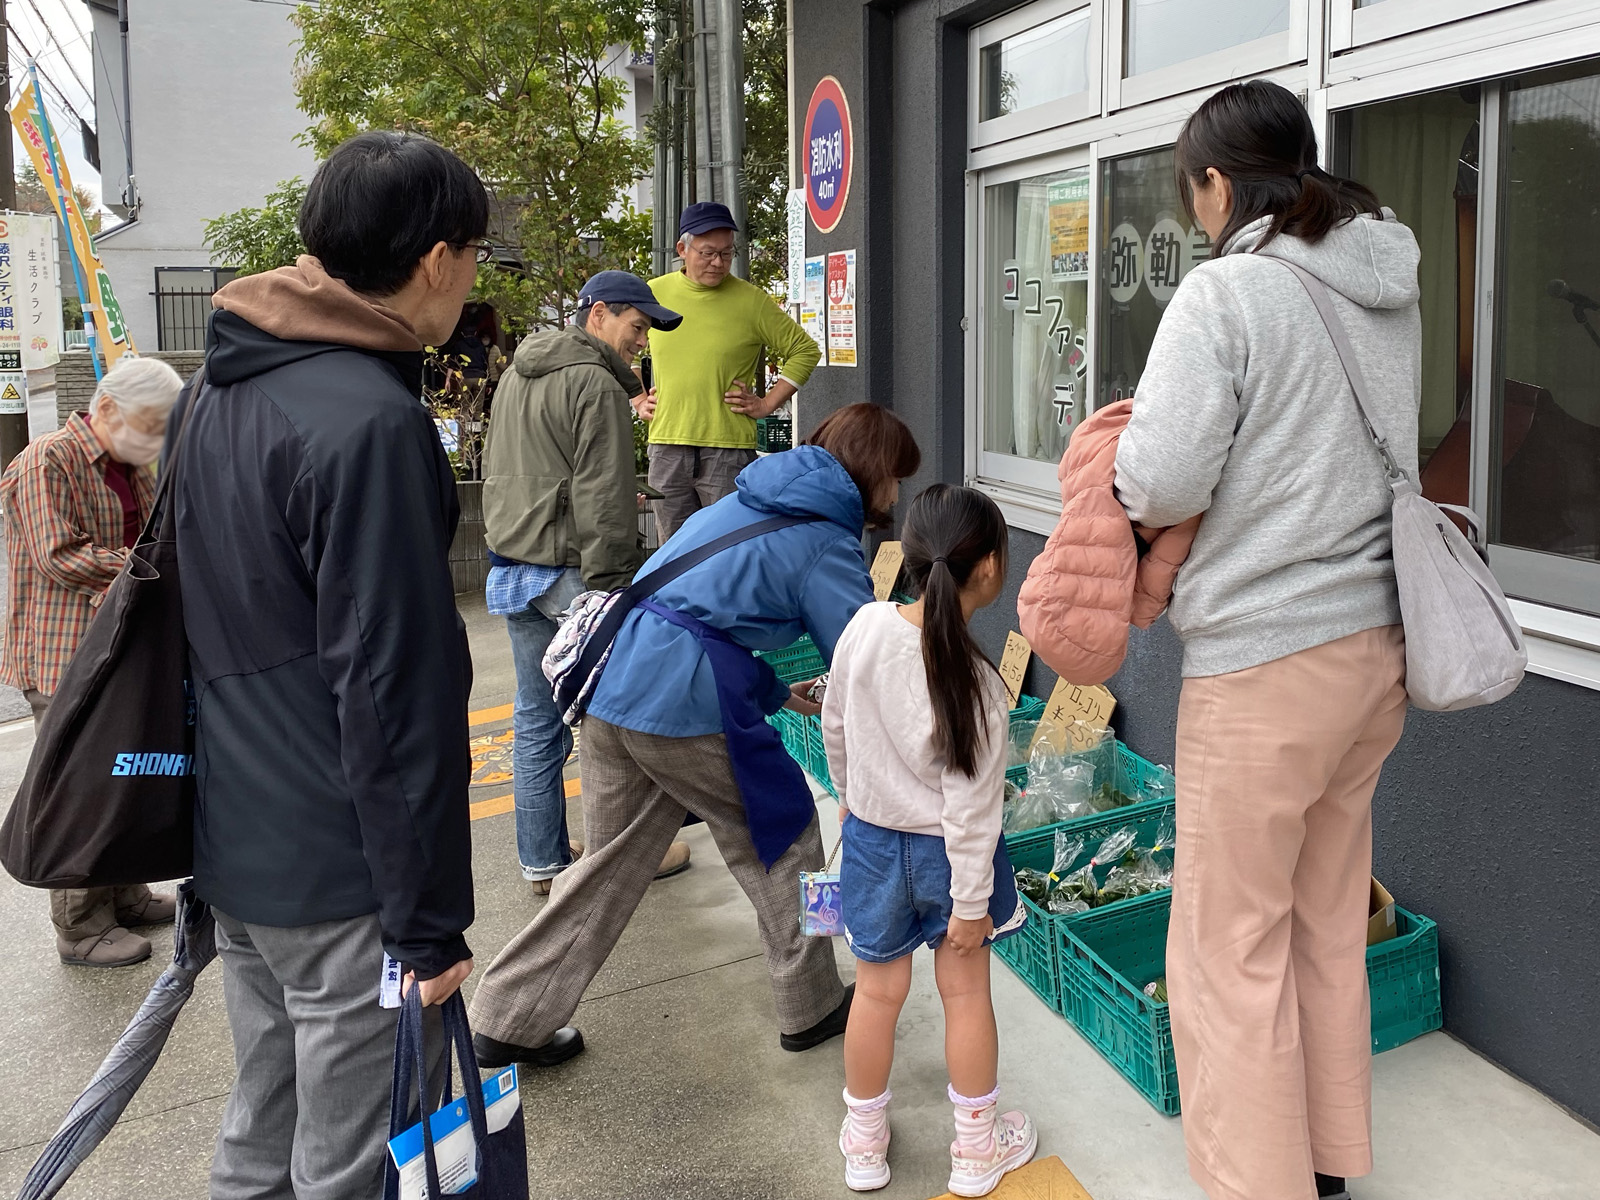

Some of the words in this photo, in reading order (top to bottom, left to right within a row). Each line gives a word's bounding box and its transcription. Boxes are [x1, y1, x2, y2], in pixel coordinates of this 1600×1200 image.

[811, 128, 843, 177] 消防水利
[28, 249, 43, 325] 生活クラブ
[830, 279, 844, 299] 急募
[1002, 660, 1022, 682] ¥150
[1052, 705, 1094, 749] ¥250
